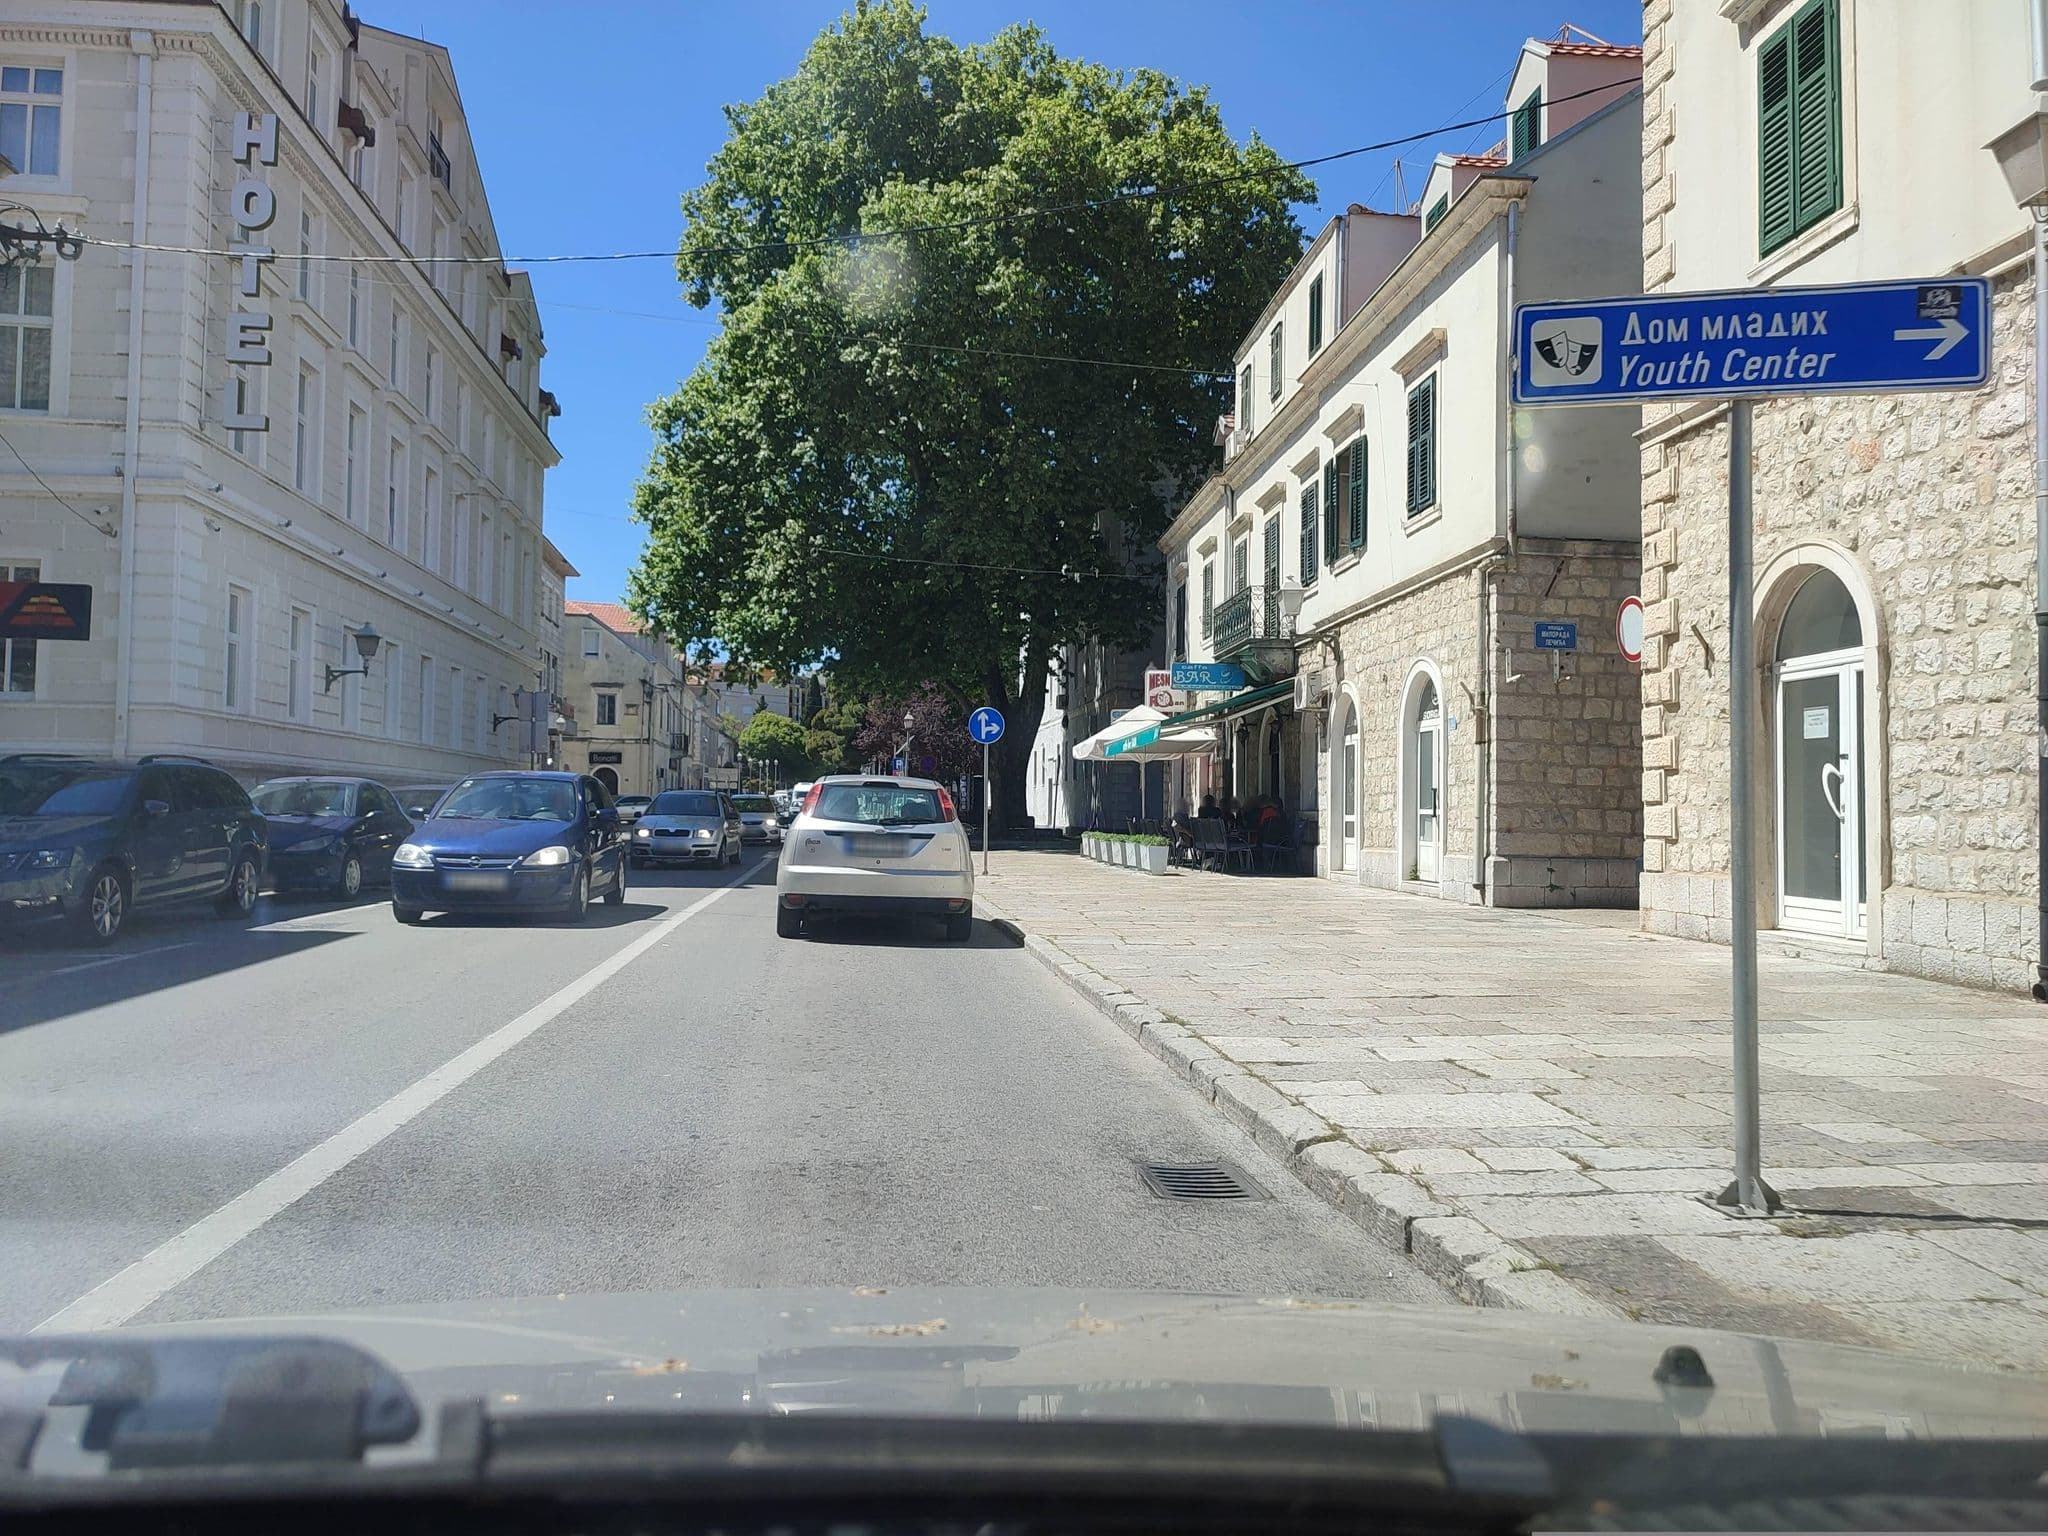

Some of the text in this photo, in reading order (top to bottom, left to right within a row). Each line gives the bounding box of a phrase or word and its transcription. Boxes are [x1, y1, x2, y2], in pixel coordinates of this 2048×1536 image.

[222, 111, 279, 432] HOTEL
[1619, 310, 1828, 346] Дом младих
[1619, 346, 1837, 387] Youth Center
[1149, 673, 1170, 691] MESN
[1173, 670, 1217, 685] BAR
